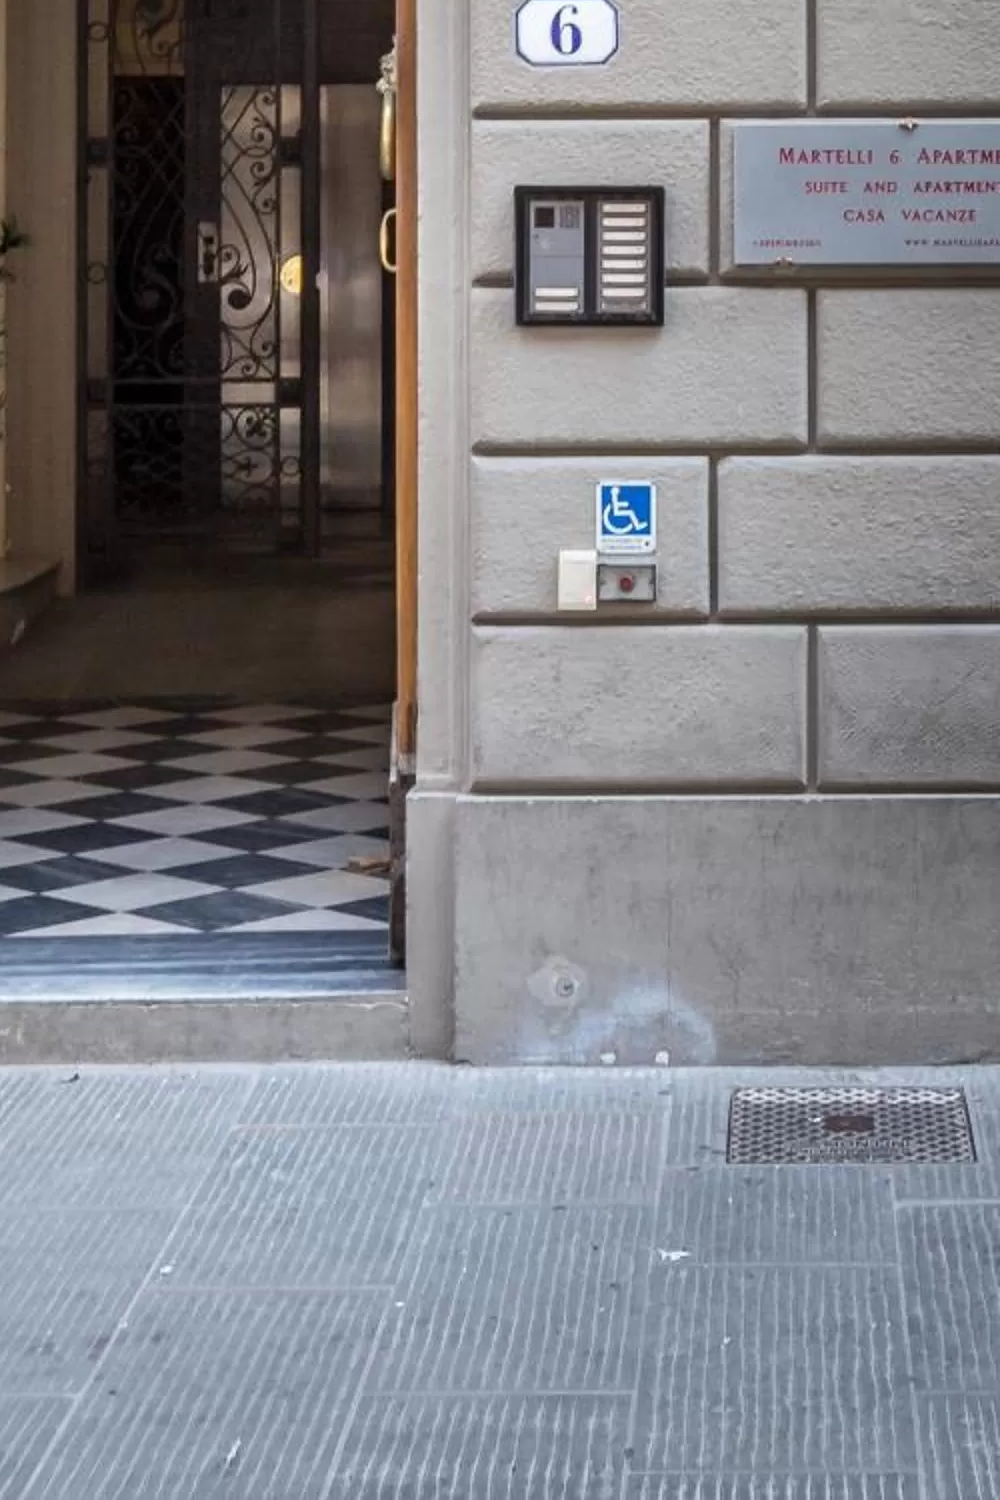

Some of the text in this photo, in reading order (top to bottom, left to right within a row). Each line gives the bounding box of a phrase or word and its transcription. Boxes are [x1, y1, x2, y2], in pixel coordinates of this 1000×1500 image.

[551, 4, 583, 55] 6
[778, 147, 873, 165] MARTELLI
[889, 149, 901, 165] 6
[804, 181, 849, 194] SUITE
[863, 181, 898, 194] AND
[842, 208, 976, 222] CASA VACANZE
